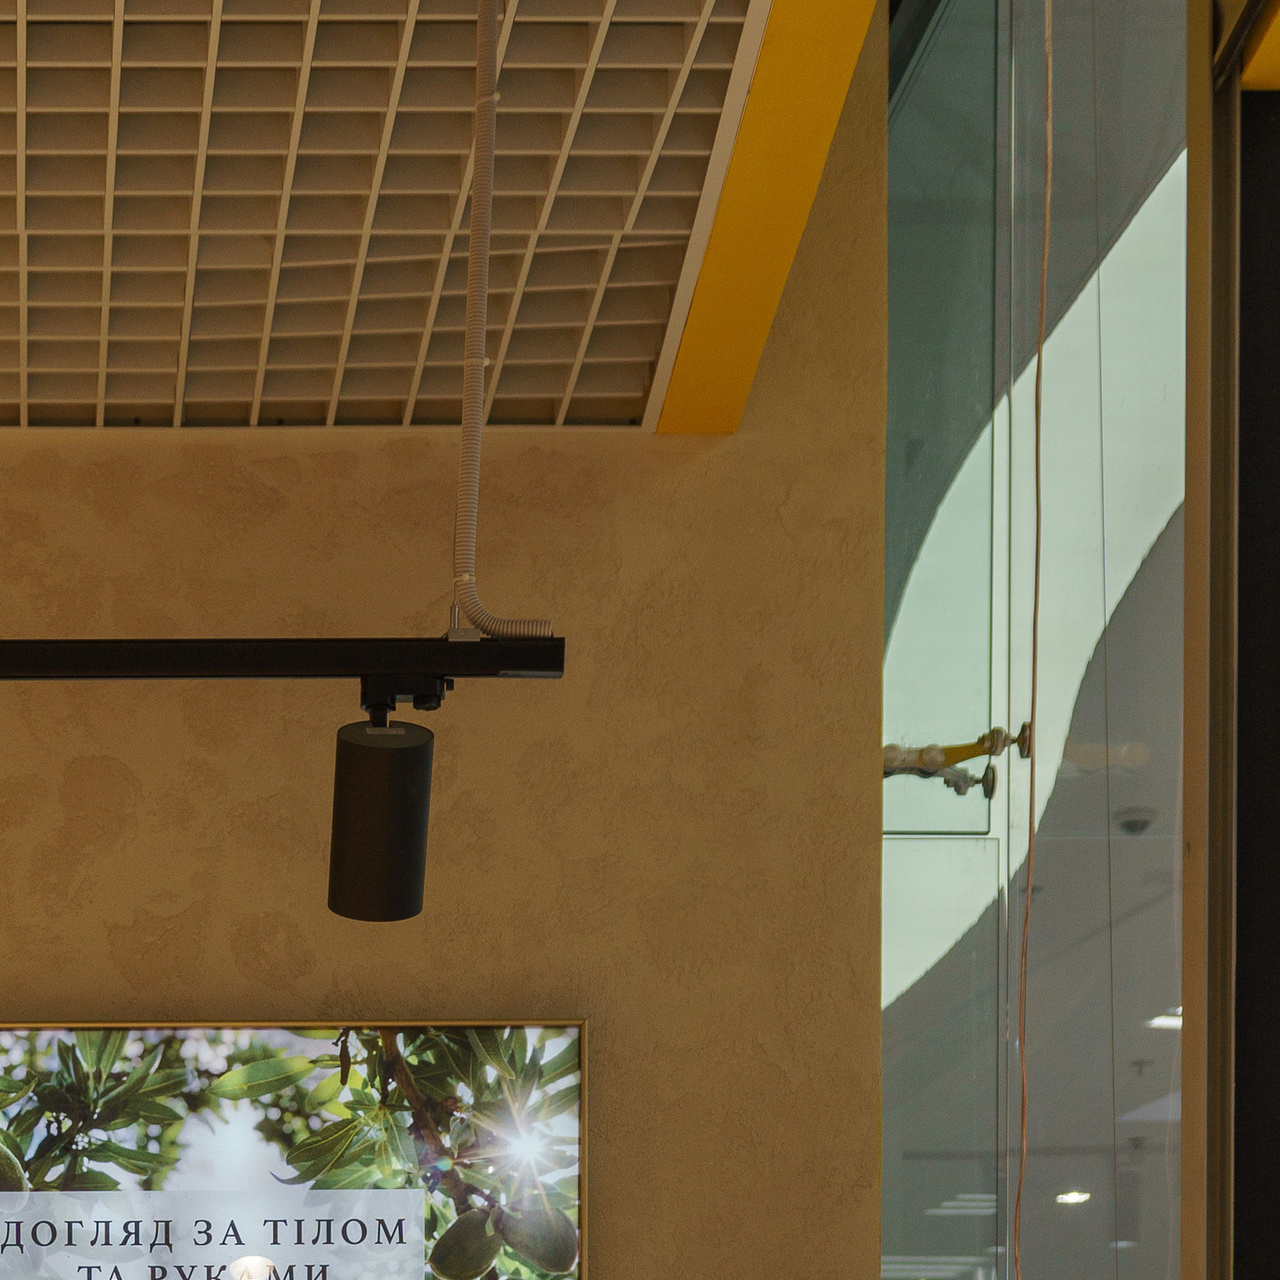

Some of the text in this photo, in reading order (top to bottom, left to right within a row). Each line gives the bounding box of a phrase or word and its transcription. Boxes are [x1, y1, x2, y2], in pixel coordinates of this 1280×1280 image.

[1, 1219, 407, 1254] ДОГЛЯД ЗА ТІЛОМ
